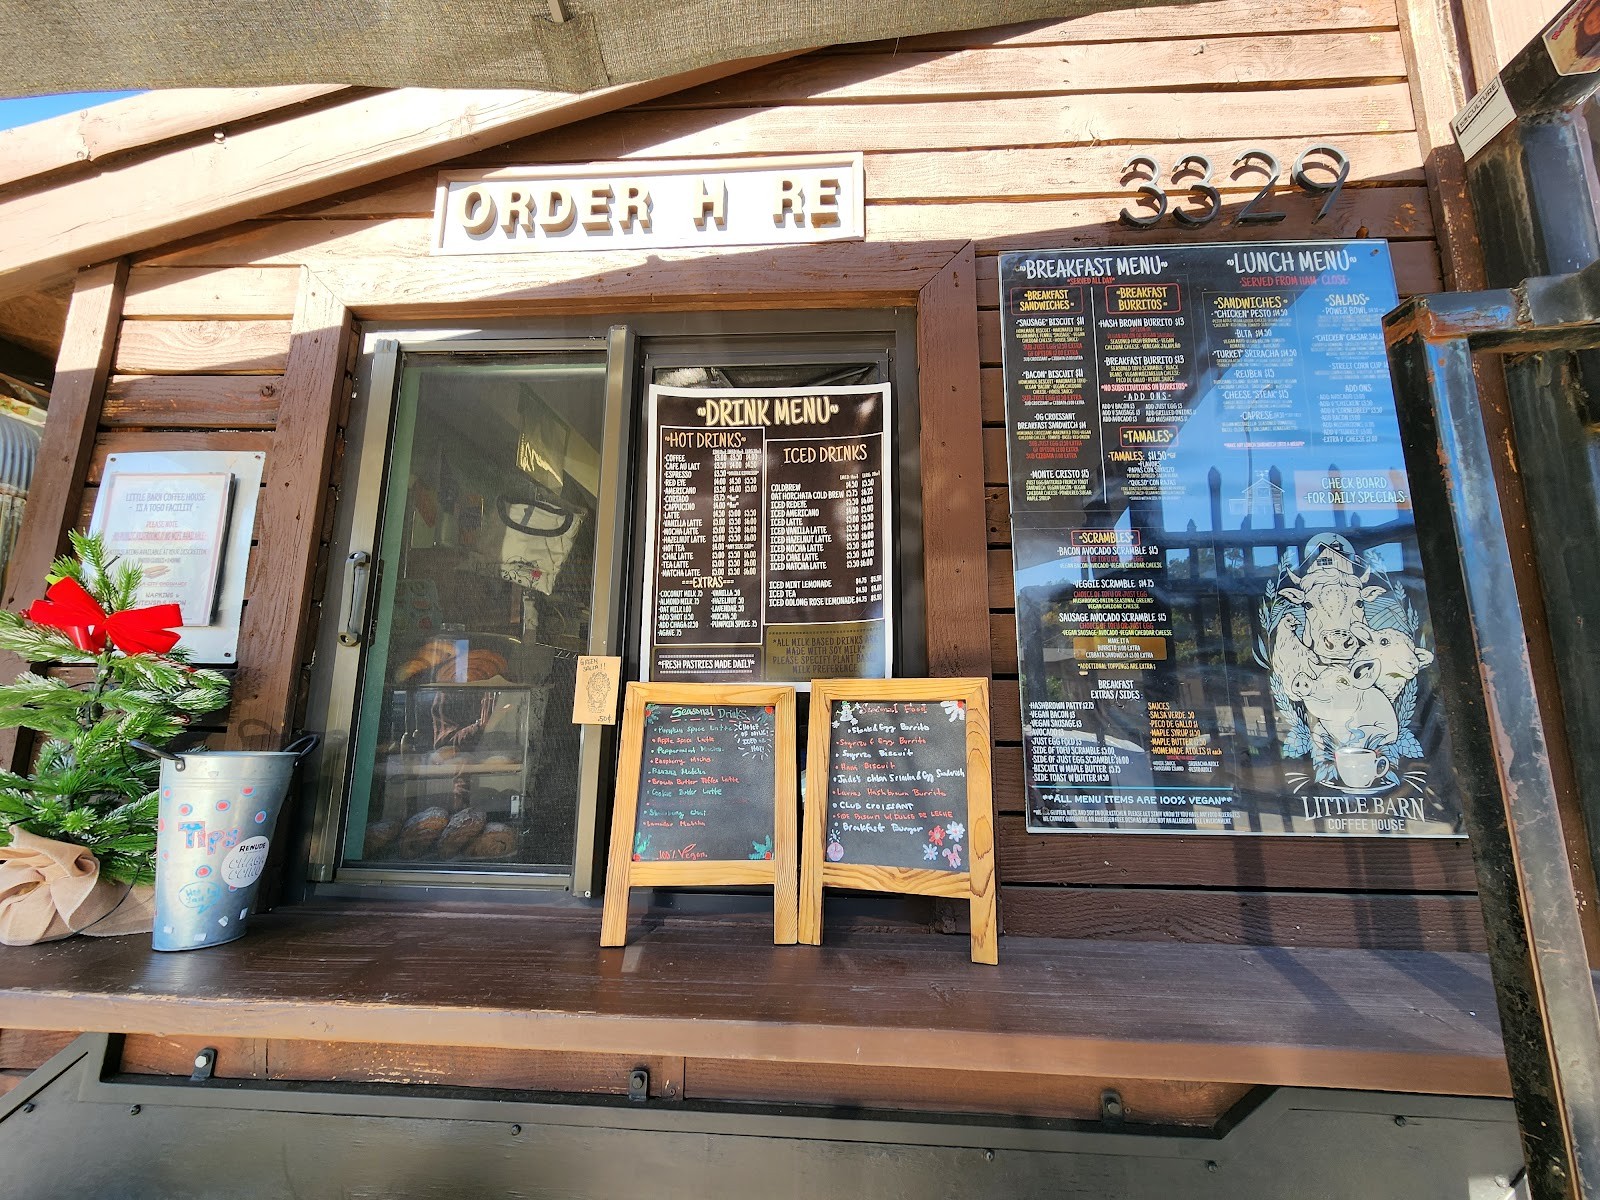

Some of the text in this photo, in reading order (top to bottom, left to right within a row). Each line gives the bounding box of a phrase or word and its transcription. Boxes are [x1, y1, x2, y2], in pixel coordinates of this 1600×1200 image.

[1119, 144, 1350, 228] 3329
[460, 184, 654, 240] ORDER
[1234, 250, 1350, 274] LUNCH MENU
[1026, 256, 1162, 279] BREAKFAST MENU
[1241, 277, 1274, 287] SERVED
[1276, 277, 1297, 286] FROM
[1322, 275, 1348, 284] CLOSE
[1027, 290, 1068, 300] BREAKFAST
[1120, 287, 1167, 298] BREAKFAST
[1119, 299, 1162, 311] BURRITOS
[1218, 296, 1281, 309] SANDWICHES
[1329, 294, 1366, 306] SALADS
[1020, 300, 1070, 311] SANDWICHES
[1251, 309, 1271, 317] PESTO
[1326, 307, 1348, 315] POWER
[1049, 318, 1074, 326] BISCUIT
[1119, 319, 1142, 327] BROWN
[1144, 318, 1173, 327] BURRITO
[1175, 318, 1184, 326] $13
[1236, 330, 1252, 338] BLTA
[1245, 350, 1279, 358] SRIRACHA
[1106, 356, 1185, 365] BREAKFAST BURRITO $13
[1050, 370, 1074, 378] BISCUIT
[1235, 369, 1274, 378] REUBEN $15
[1224, 391, 1252, 400] CHEESE
[1279, 390, 1288, 399] $15
[705, 396, 830, 426] DRINK MENU
[1242, 411, 1274, 420] CAPRESE
[670, 432, 742, 448] HOT DRINKS
[1127, 430, 1170, 443] TAMALES
[784, 444, 867, 463] ICED DRINKS
[688, 463, 700, 471] LAIT
[1032, 469, 1089, 479] MONTE CRISTO $15
[1322, 477, 1387, 489] CHECK BOARD
[813, 491, 827, 499] COLD
[828, 490, 844, 498] BREW
[1328, 491, 1355, 503] DAILY
[771, 510, 785, 518] ICED
[1082, 532, 1131, 544] SCRAMBLES
[678, 552, 693, 560] LATTE
[1059, 546, 1158, 556] BACON AVOCADO SCRAMBLE $15
[693, 576, 723, 588] EXTRAS
[769, 580, 832, 589] ICED MINT LEMONADE
[1075, 579, 1100, 588] VEGGIE
[1101, 579, 1135, 588] SCRAMBLE
[769, 590, 796, 598] ICED TEA
[1059, 613, 1166, 622] SAUSAGE AVOCADO SCRAMBLE $15
[792, 638, 809, 646] MILK
[812, 637, 835, 646] BASED
[837, 636, 863, 645] DRINKS
[786, 646, 841, 655] MADE WITH SOY
[683, 660, 713, 669] PASTRIES
[714, 660, 732, 668] MADE
[1098, 680, 1134, 689] BREAKFAST
[1091, 690, 1114, 699] EXTRAS
[670, 706, 714, 718] Seasonal
[1034, 765, 1058, 773] BISCUIT
[1066, 765, 1084, 773] MAPLE
[1085, 765, 1107, 773] BUTTER
[1074, 795, 1102, 804] MENU
[1105, 796, 1134, 804] ITEMS
[1137, 796, 1157, 804] ARE
[1160, 796, 1186, 804] 100%
[1301, 797, 1425, 822] LITTLE BARN
[1328, 819, 1405, 831] COFFEE HOUSE
